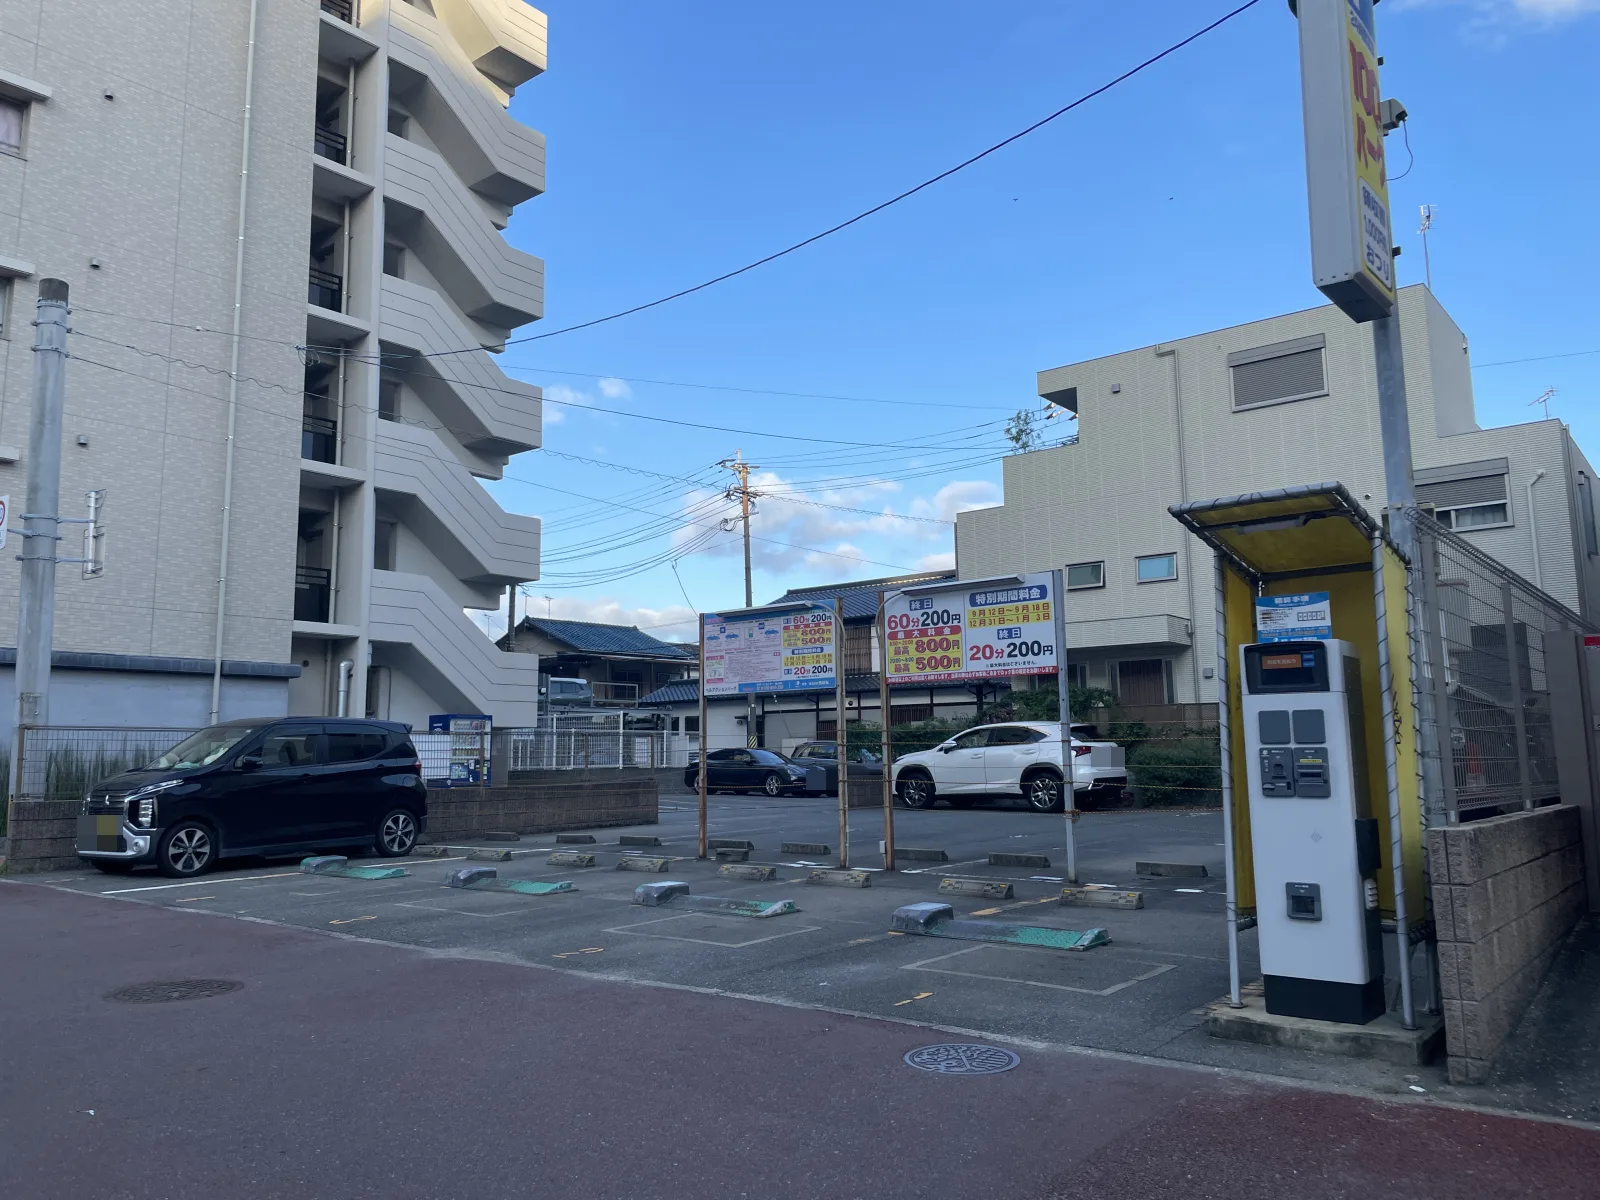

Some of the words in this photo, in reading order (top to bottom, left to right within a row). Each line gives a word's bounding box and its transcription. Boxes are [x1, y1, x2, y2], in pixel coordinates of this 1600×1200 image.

[1366, 242, 1389, 281] おつり
[976, 587, 1040, 604] 特別期間料金
[911, 600, 931, 609] 終日
[898, 626, 950, 639] 最大料金
[999, 628, 1019, 639] 終日
[894, 646, 909, 655] 最高
[915, 637, 959, 653] 800円
[895, 663, 910, 673] 最高
[916, 655, 960, 671] 500円
